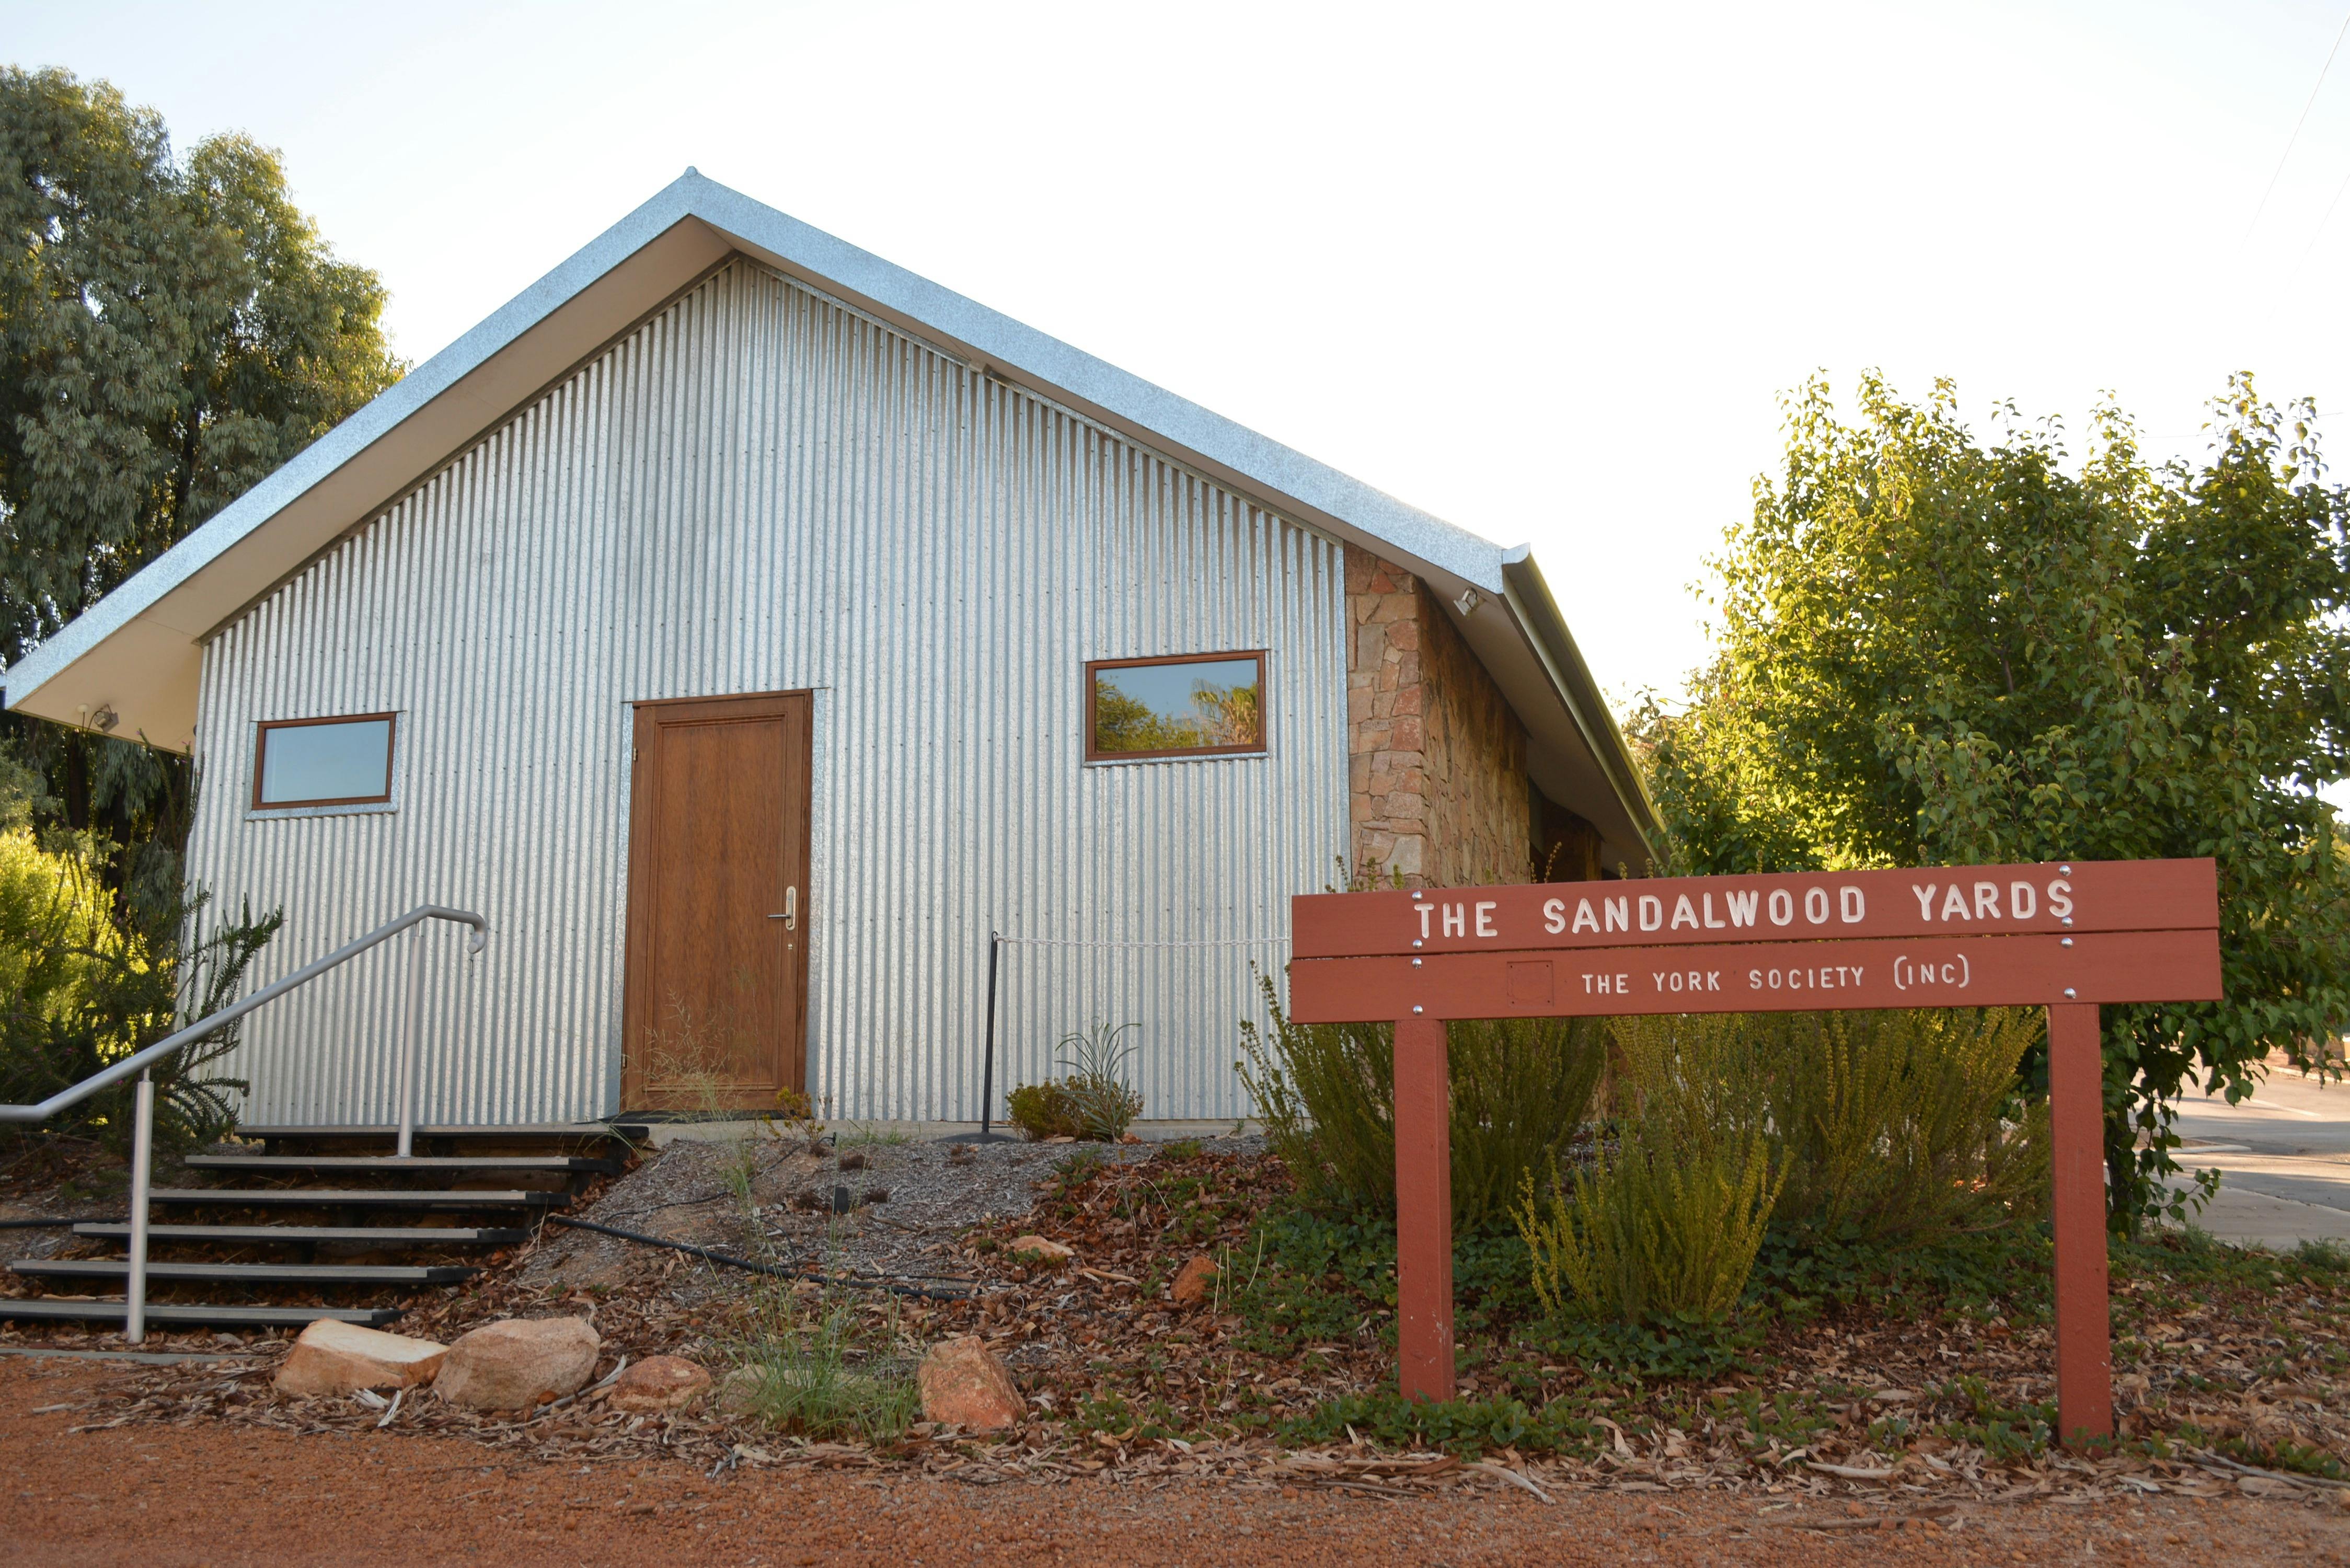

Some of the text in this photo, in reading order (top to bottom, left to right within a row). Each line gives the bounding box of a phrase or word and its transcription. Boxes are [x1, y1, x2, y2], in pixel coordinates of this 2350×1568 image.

[1414, 879, 2073, 939] THE SANDALWOOD YARDS
[1582, 953, 1969, 994] THE YORK SOCIETY (INC)
